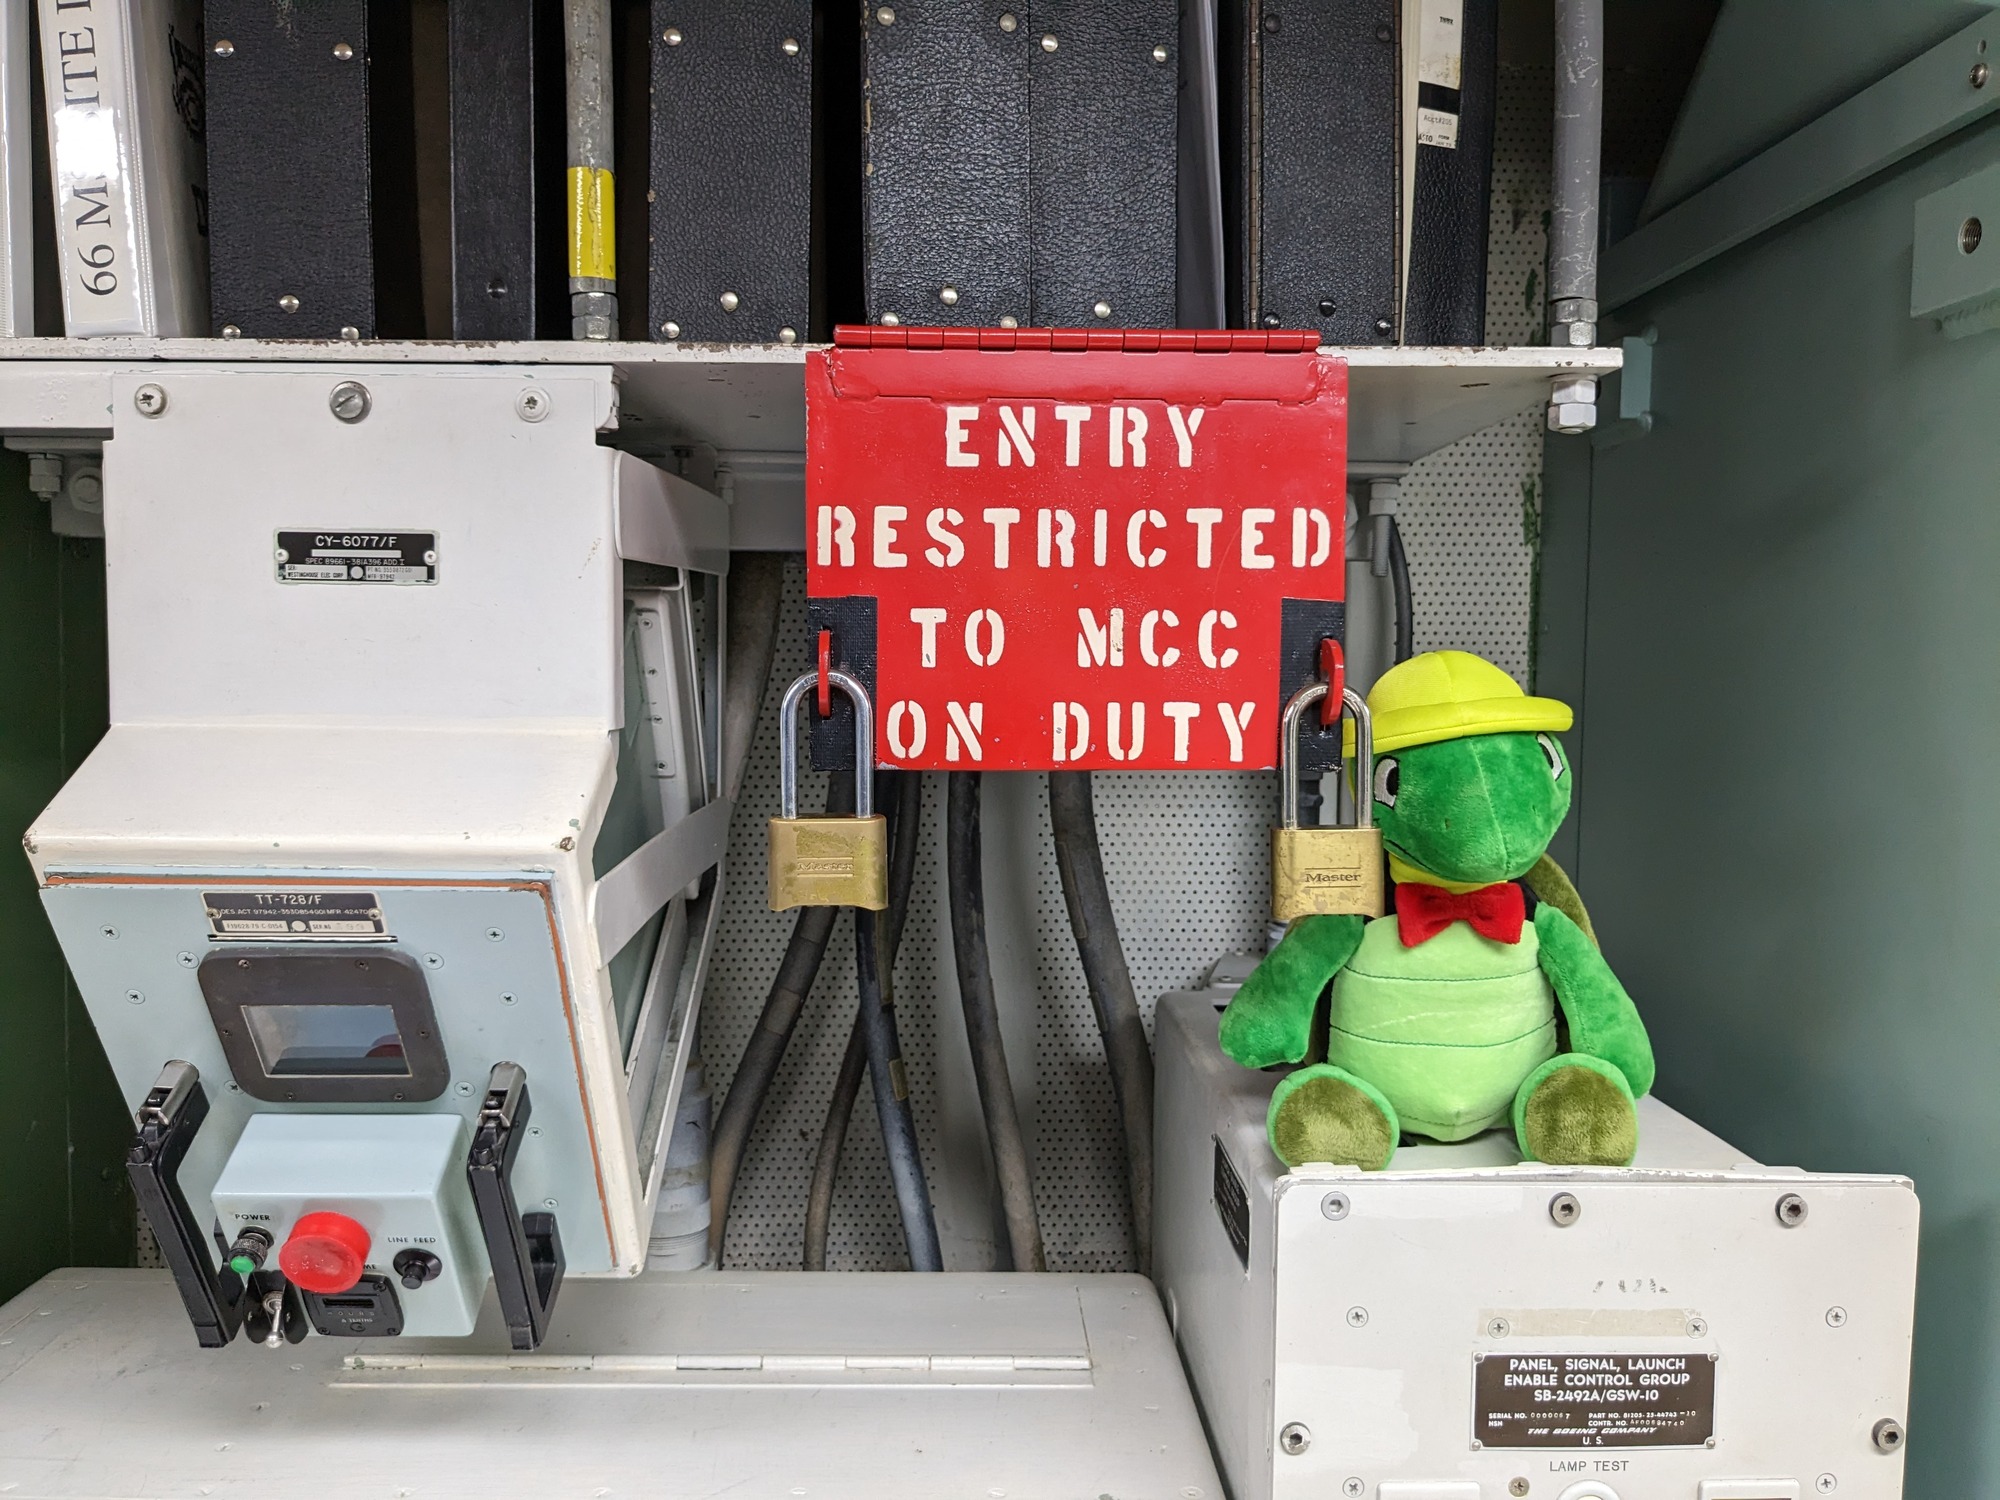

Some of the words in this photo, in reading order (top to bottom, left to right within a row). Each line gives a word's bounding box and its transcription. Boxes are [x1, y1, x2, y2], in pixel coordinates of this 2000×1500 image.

[58, 26, 101, 118] ITE
[77, 244, 118, 296] 66
[946, 406, 1204, 468] ENTRY
[315, 535, 398, 548] CY-6077/F
[817, 505, 1331, 569] RESTRICTED
[305, 557, 323, 565] SPEC
[910, 608, 1005, 668] TO
[1077, 608, 1239, 668] MCC
[887, 700, 984, 761] ON
[1052, 701, 1256, 762] DUTY
[797, 861, 854, 871] Master
[1304, 873, 1361, 883] Master
[255, 894, 322, 905] TT-728/F
[235, 1213, 271, 1221] POWER
[1509, 1358, 1558, 1372] PANEL,
[1565, 1358, 1620, 1373] SIGNAL,
[1627, 1358, 1686, 1370] LAUNCH
[1504, 1374, 1558, 1386] ENABLE
[1564, 1374, 1633, 1386] CONTROL
[1639, 1373, 1690, 1386] GROUP
[1534, 1389, 1659, 1403] SB-2492A/GSW-10
[1582, 1436, 1592, 1445] U.
[1595, 1436, 1604, 1445] S.
[1549, 1460, 1587, 1472] LAMP
[1593, 1460, 1629, 1472] TEST
